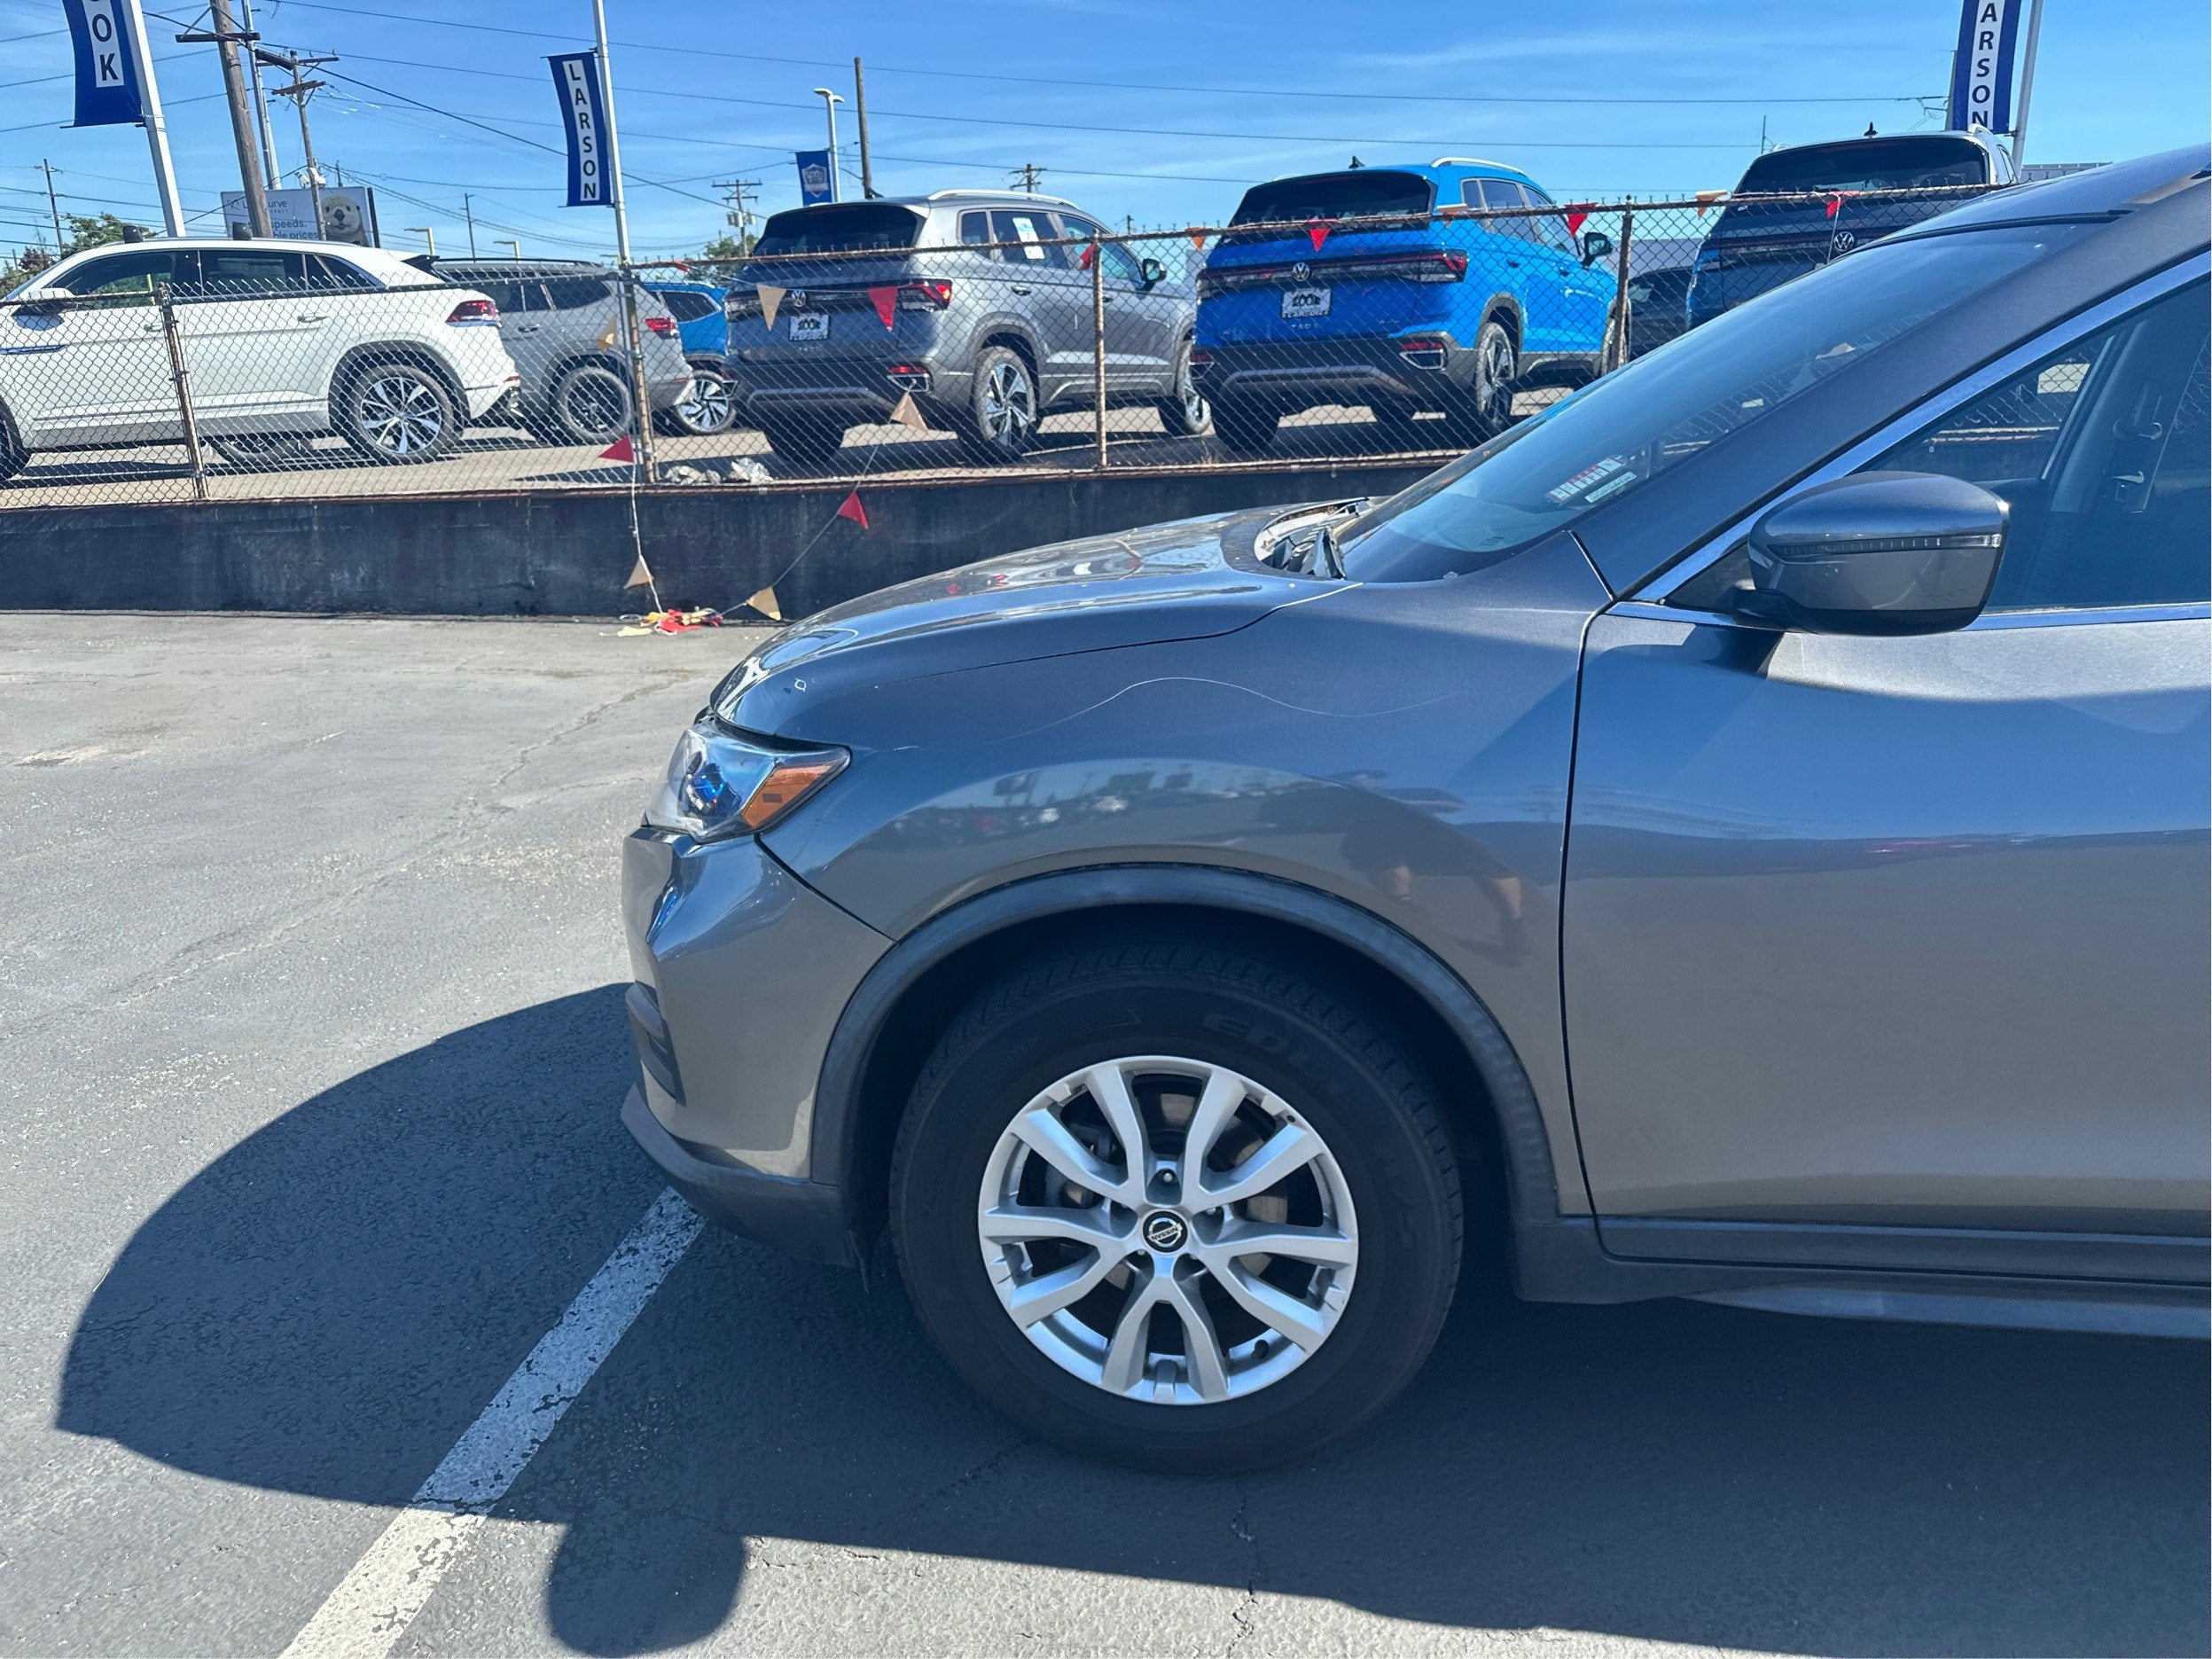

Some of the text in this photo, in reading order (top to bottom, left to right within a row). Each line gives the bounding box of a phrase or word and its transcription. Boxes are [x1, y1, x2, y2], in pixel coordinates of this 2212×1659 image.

[90, 0, 118, 81] OK
[568, 63, 597, 199] LARSON
[1152, 1227, 1178, 1240] NISSAN
